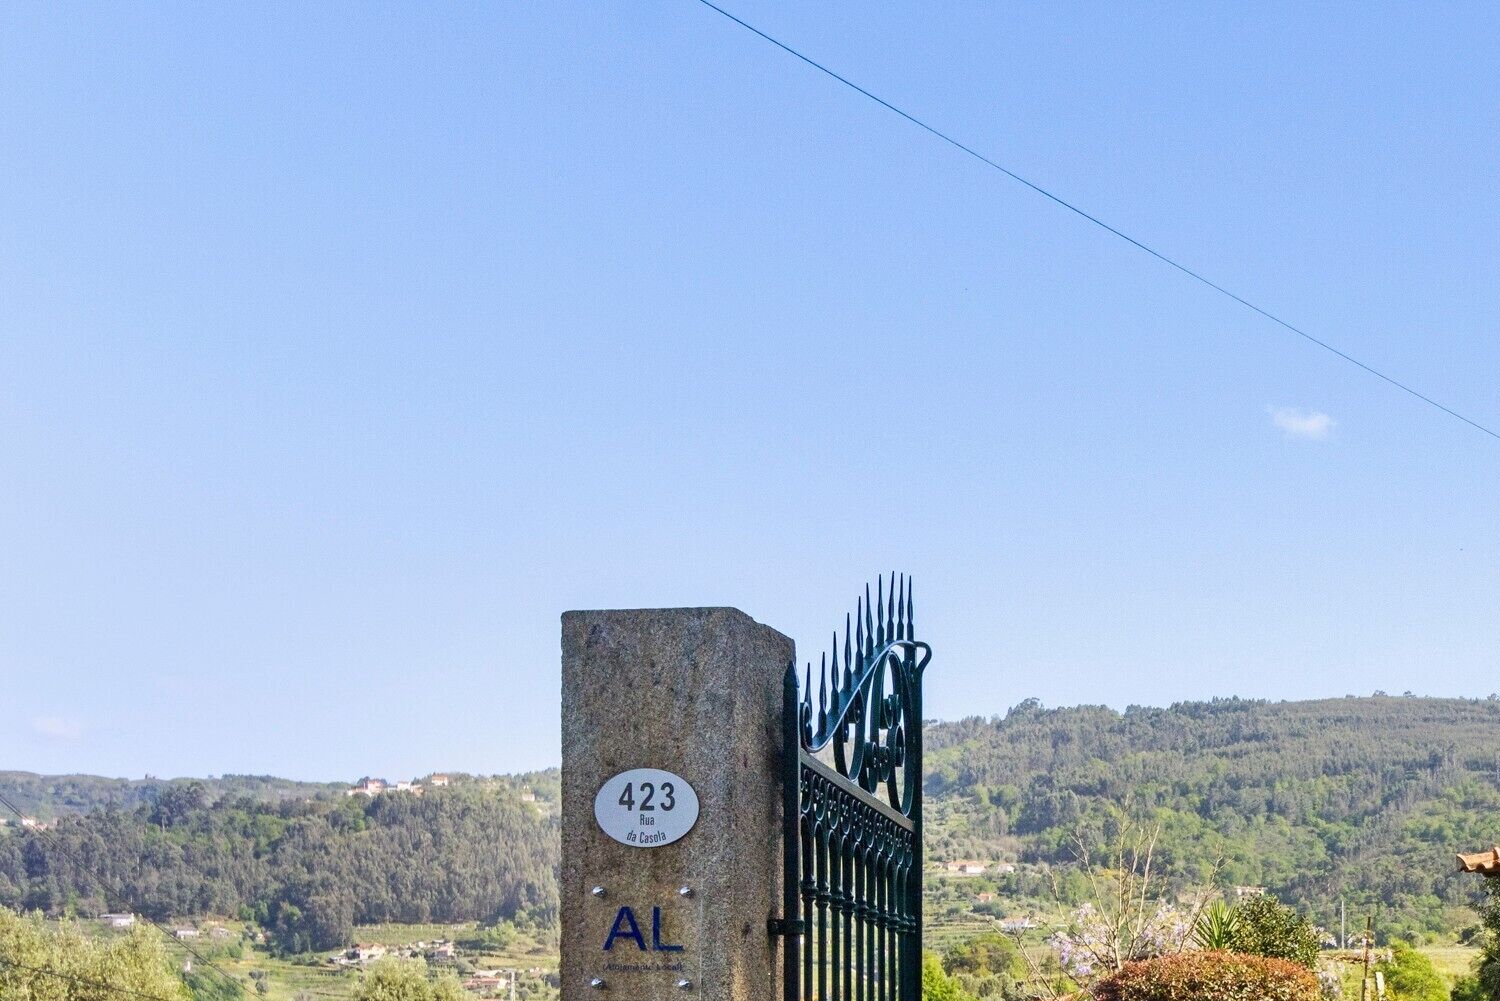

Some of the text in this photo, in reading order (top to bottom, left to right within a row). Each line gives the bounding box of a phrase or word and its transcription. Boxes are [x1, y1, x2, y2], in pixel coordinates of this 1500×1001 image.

[619, 782, 675, 811] 423
[640, 814, 655, 826] Rua
[627, 830, 667, 843] da Casola
[603, 906, 683, 951] AL
